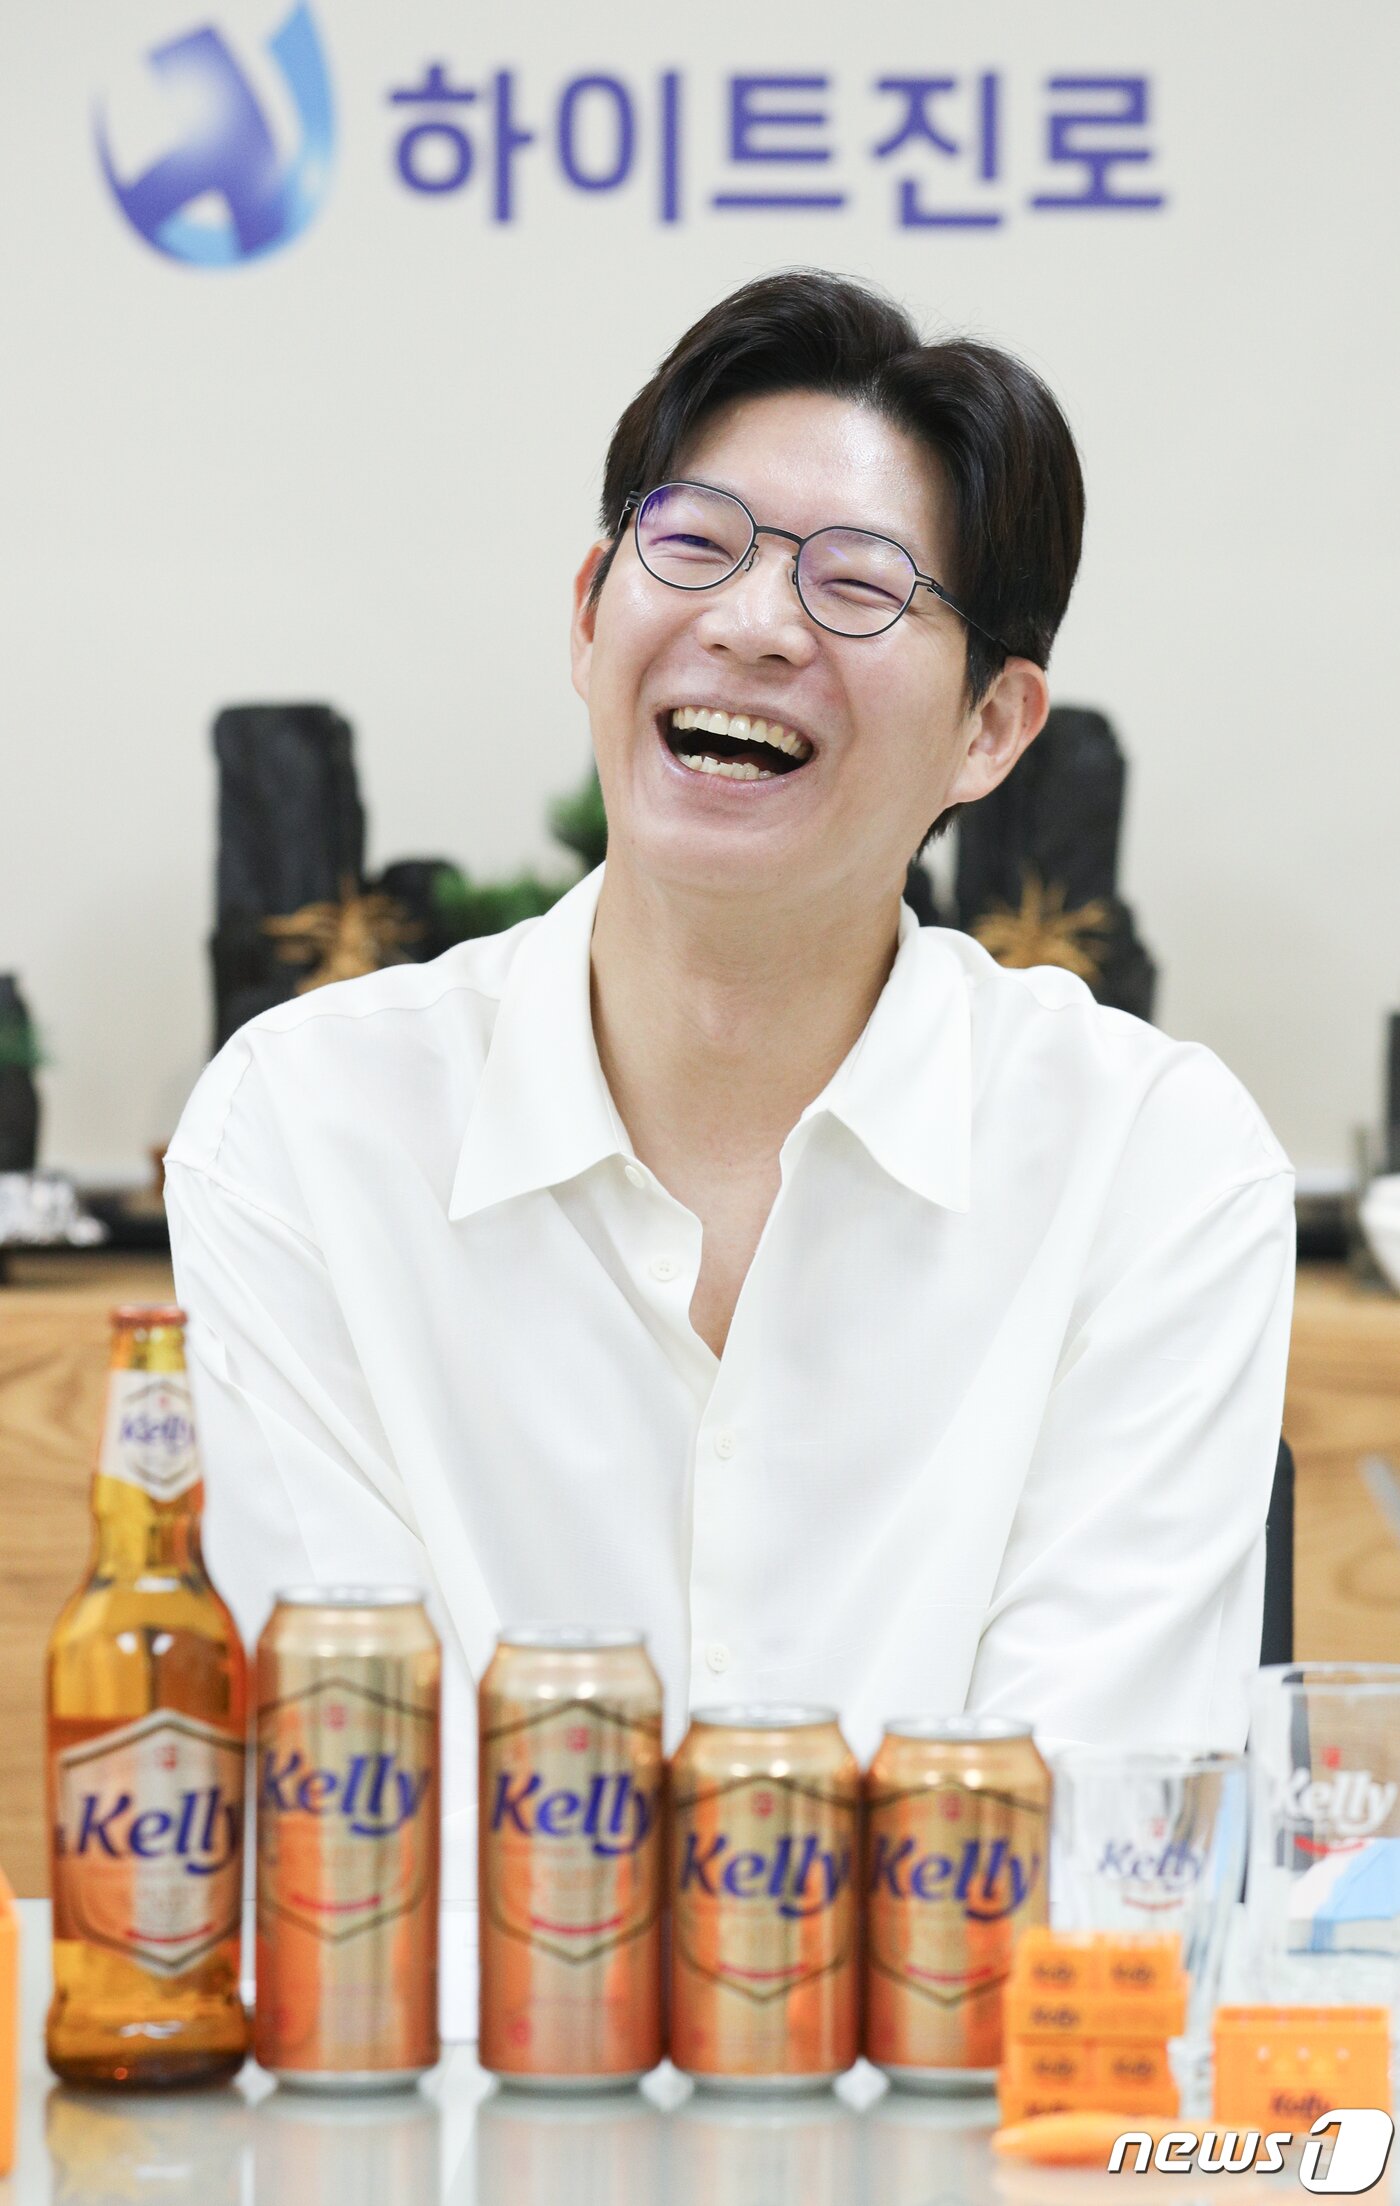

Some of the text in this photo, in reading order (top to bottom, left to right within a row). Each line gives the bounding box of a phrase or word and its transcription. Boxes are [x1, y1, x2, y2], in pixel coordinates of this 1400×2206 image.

[388, 62, 1168, 231] 하이트진로
[76, 1785, 240, 1876] Kelly
[258, 1750, 433, 1837] Kelly
[490, 1771, 654, 1859] Kelly
[1279, 1767, 1398, 1835] Kelly
[678, 1832, 851, 1918] Kelly
[868, 1834, 1041, 1921] Kelly
